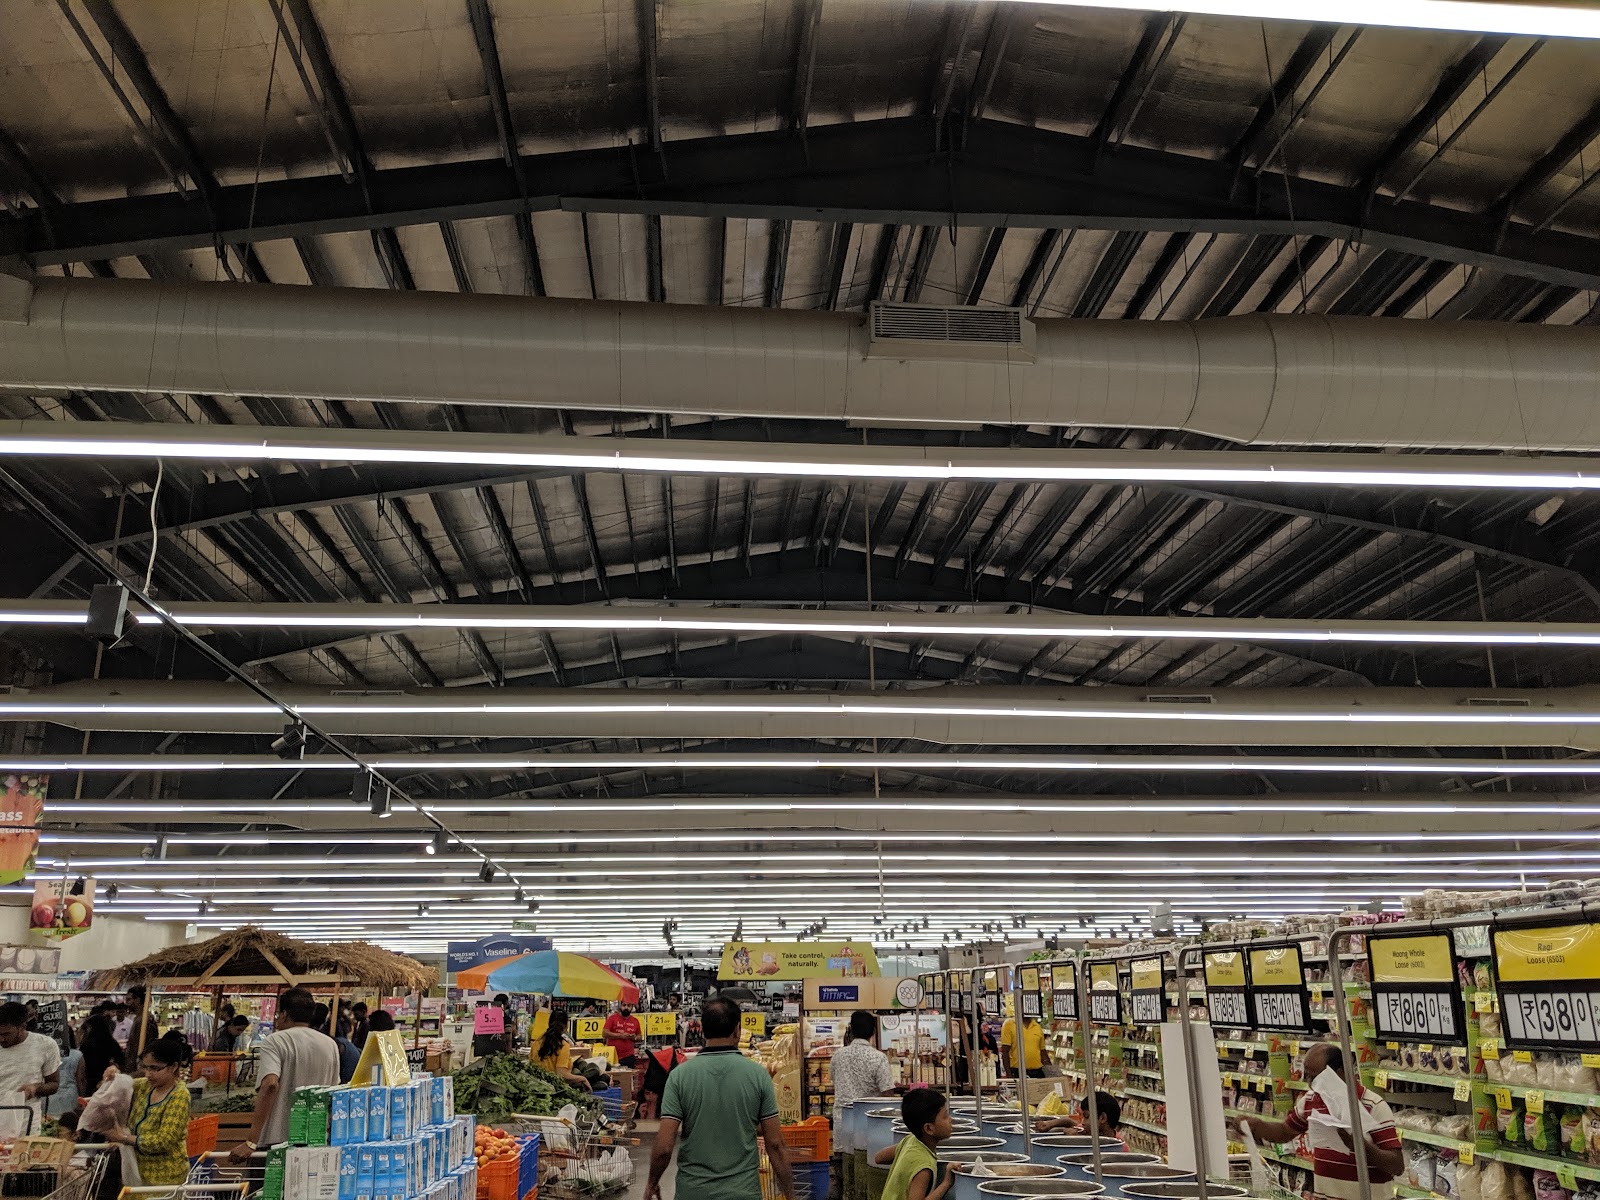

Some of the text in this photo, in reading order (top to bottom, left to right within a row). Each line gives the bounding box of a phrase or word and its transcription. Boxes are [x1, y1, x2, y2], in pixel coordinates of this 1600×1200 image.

[484, 948, 517, 956] Vaseline
[799, 952, 825, 960] control,
[788, 960, 819, 968] naturally.
[1526, 956, 1546, 965] Loose
[1395, 961, 1409, 969] Loose
[1441, 1004, 1450, 1012] Per
[744, 1017, 757, 1026] 99
[1443, 1015, 1451, 1024] Kg
[584, 1021, 599, 1032] 20
[1530, 1094, 1538, 1103] 57
